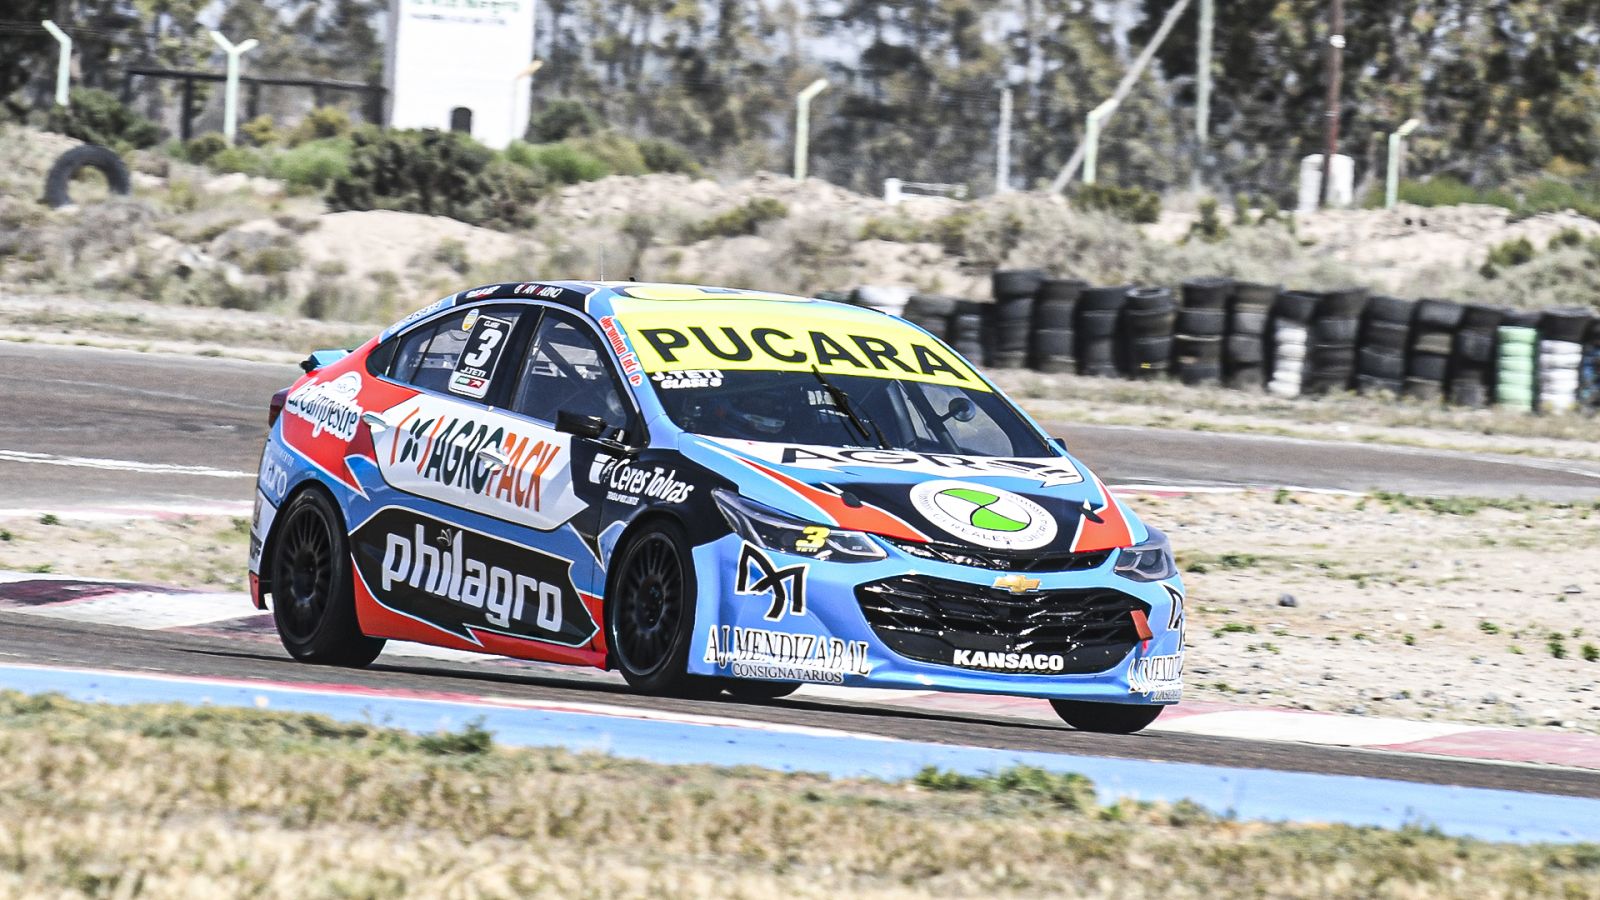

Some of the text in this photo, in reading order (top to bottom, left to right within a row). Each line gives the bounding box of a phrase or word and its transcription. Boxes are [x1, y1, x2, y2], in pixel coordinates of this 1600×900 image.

[464, 328, 503, 368] 3
[638, 327, 970, 381] PUCARA
[610, 458, 695, 504] Ceres Tolvas
[795, 526, 831, 548] 3
[382, 523, 563, 632] philagro
[732, 662, 842, 683] CONSIGNATARIOS
[953, 649, 1064, 671] KANSACO
